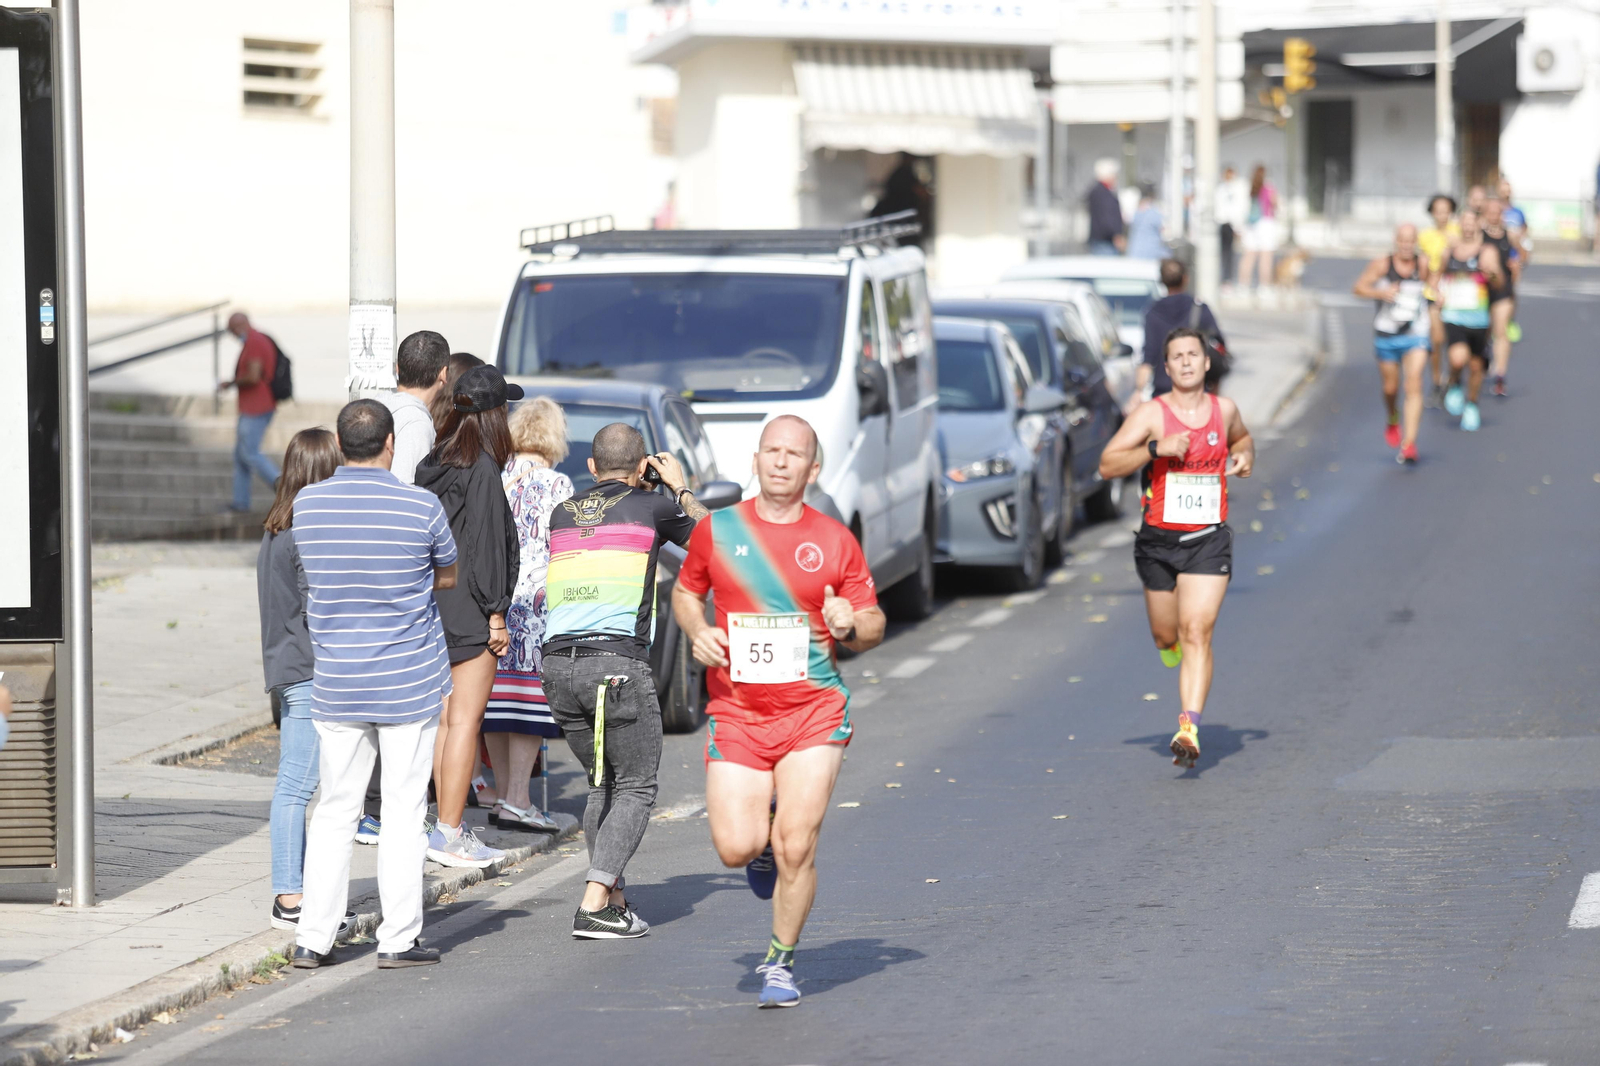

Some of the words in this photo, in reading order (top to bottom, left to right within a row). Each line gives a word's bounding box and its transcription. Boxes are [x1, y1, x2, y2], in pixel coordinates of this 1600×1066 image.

[1177, 494, 1203, 510] 104
[579, 528, 596, 539] 30
[563, 586, 599, 596] IBHOLA
[750, 643, 774, 664] 55
